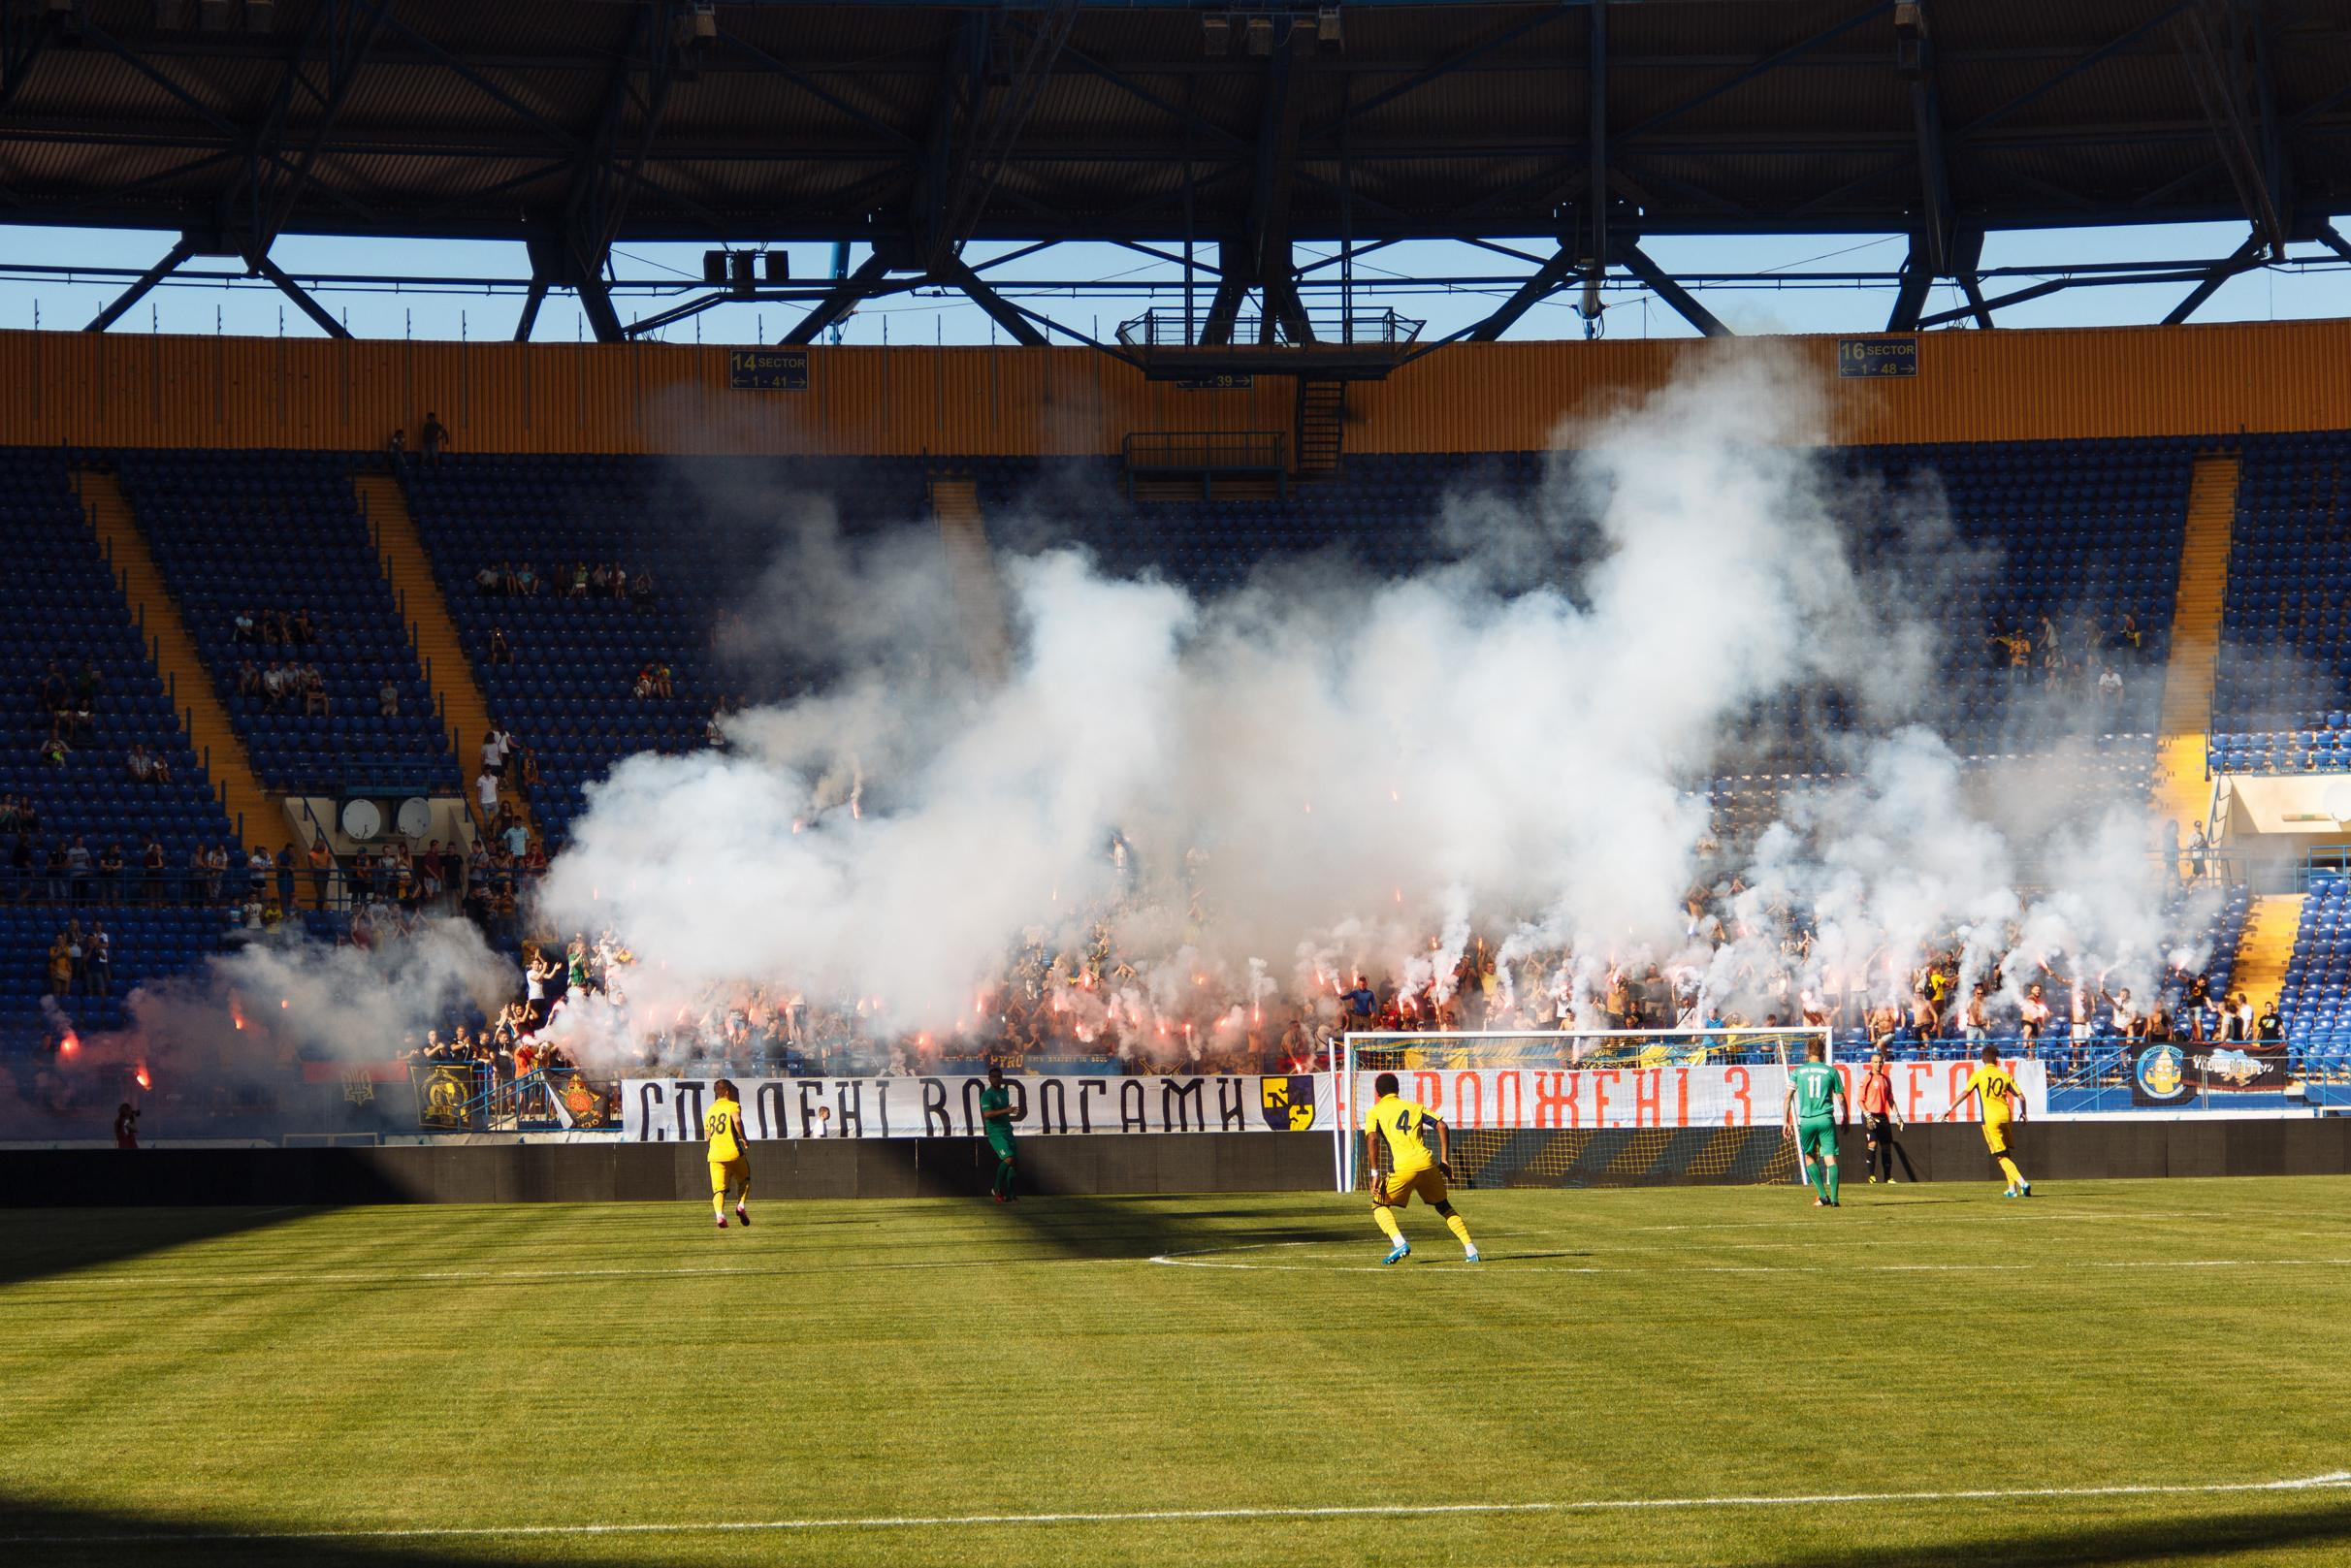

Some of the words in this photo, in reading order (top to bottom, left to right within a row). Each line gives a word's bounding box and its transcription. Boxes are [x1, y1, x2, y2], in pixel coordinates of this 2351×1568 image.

[1842, 342, 1865, 360] 16
[1867, 345, 1915, 355] SECTOR
[733, 354, 756, 371] 14
[758, 357, 805, 368] SECTOR
[1861, 365, 1867, 374] 1
[1881, 364, 1897, 374] 48
[753, 375, 758, 387] 1
[772, 375, 788, 387] 41
[1217, 374, 1233, 387] 39
[989, 1054, 1024, 1069] PYRO
[1808, 1074, 1821, 1099] 11
[1986, 1076, 2004, 1098] 10
[640, 1080, 889, 1141] СПЛЕНІ
[709, 1112, 727, 1135] 88
[1396, 1109, 1412, 1136] 4
